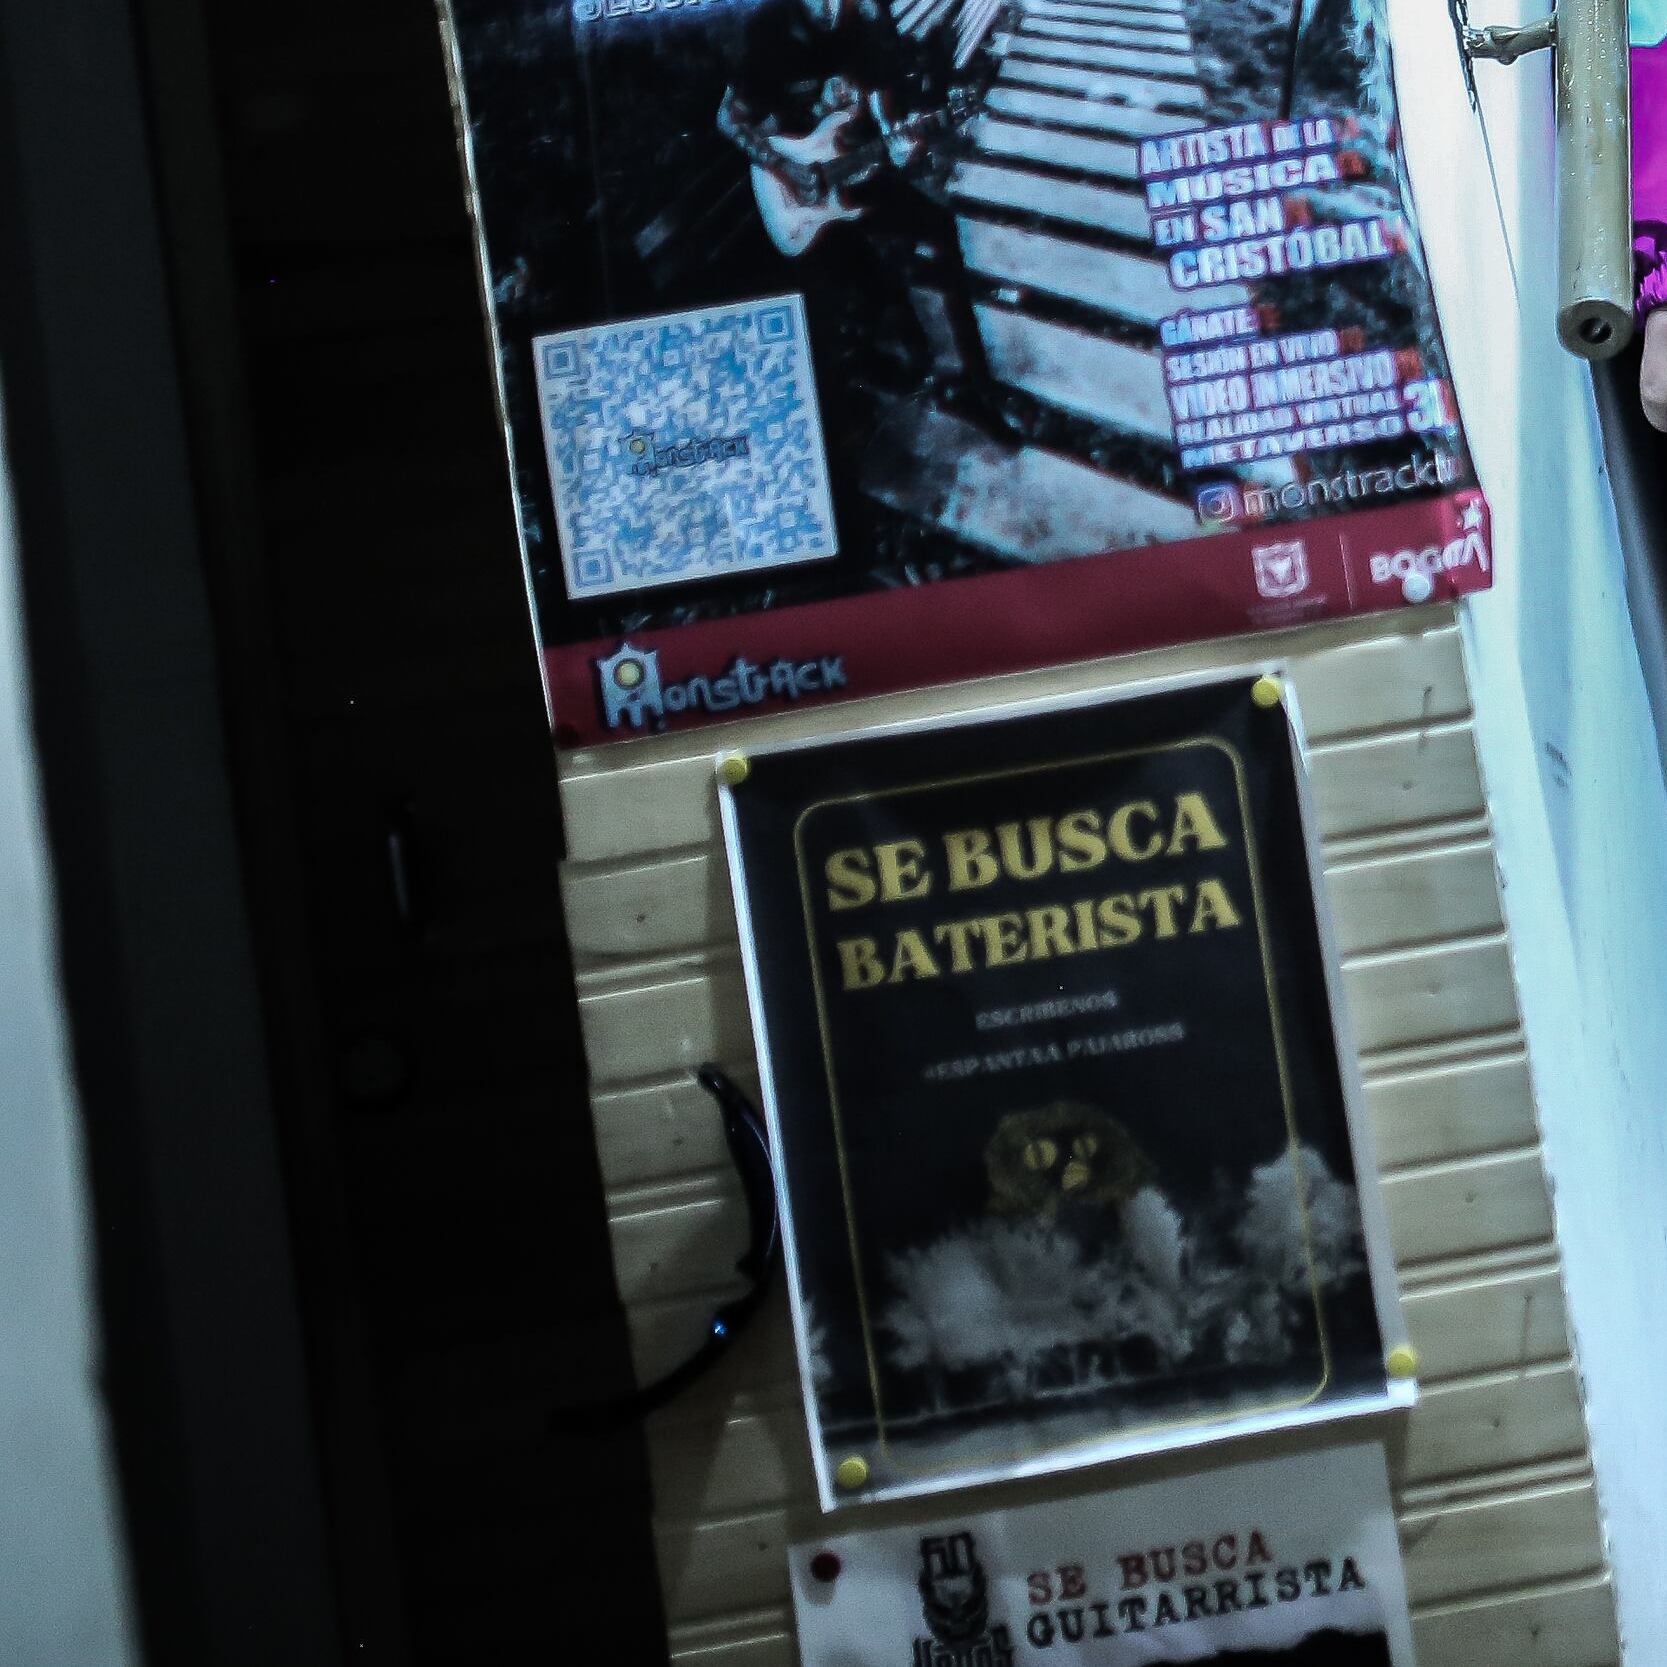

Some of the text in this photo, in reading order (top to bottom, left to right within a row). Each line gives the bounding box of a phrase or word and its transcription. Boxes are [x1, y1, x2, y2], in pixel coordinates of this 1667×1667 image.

[1201, 195, 1283, 242] SAN
[825, 791, 1228, 912] SE BUSCA
[836, 877, 1242, 992] BATERISTA
[1026, 1556, 1367, 1650] GUITARRISTA
[1027, 1531, 1273, 1605] SE BUSCA
